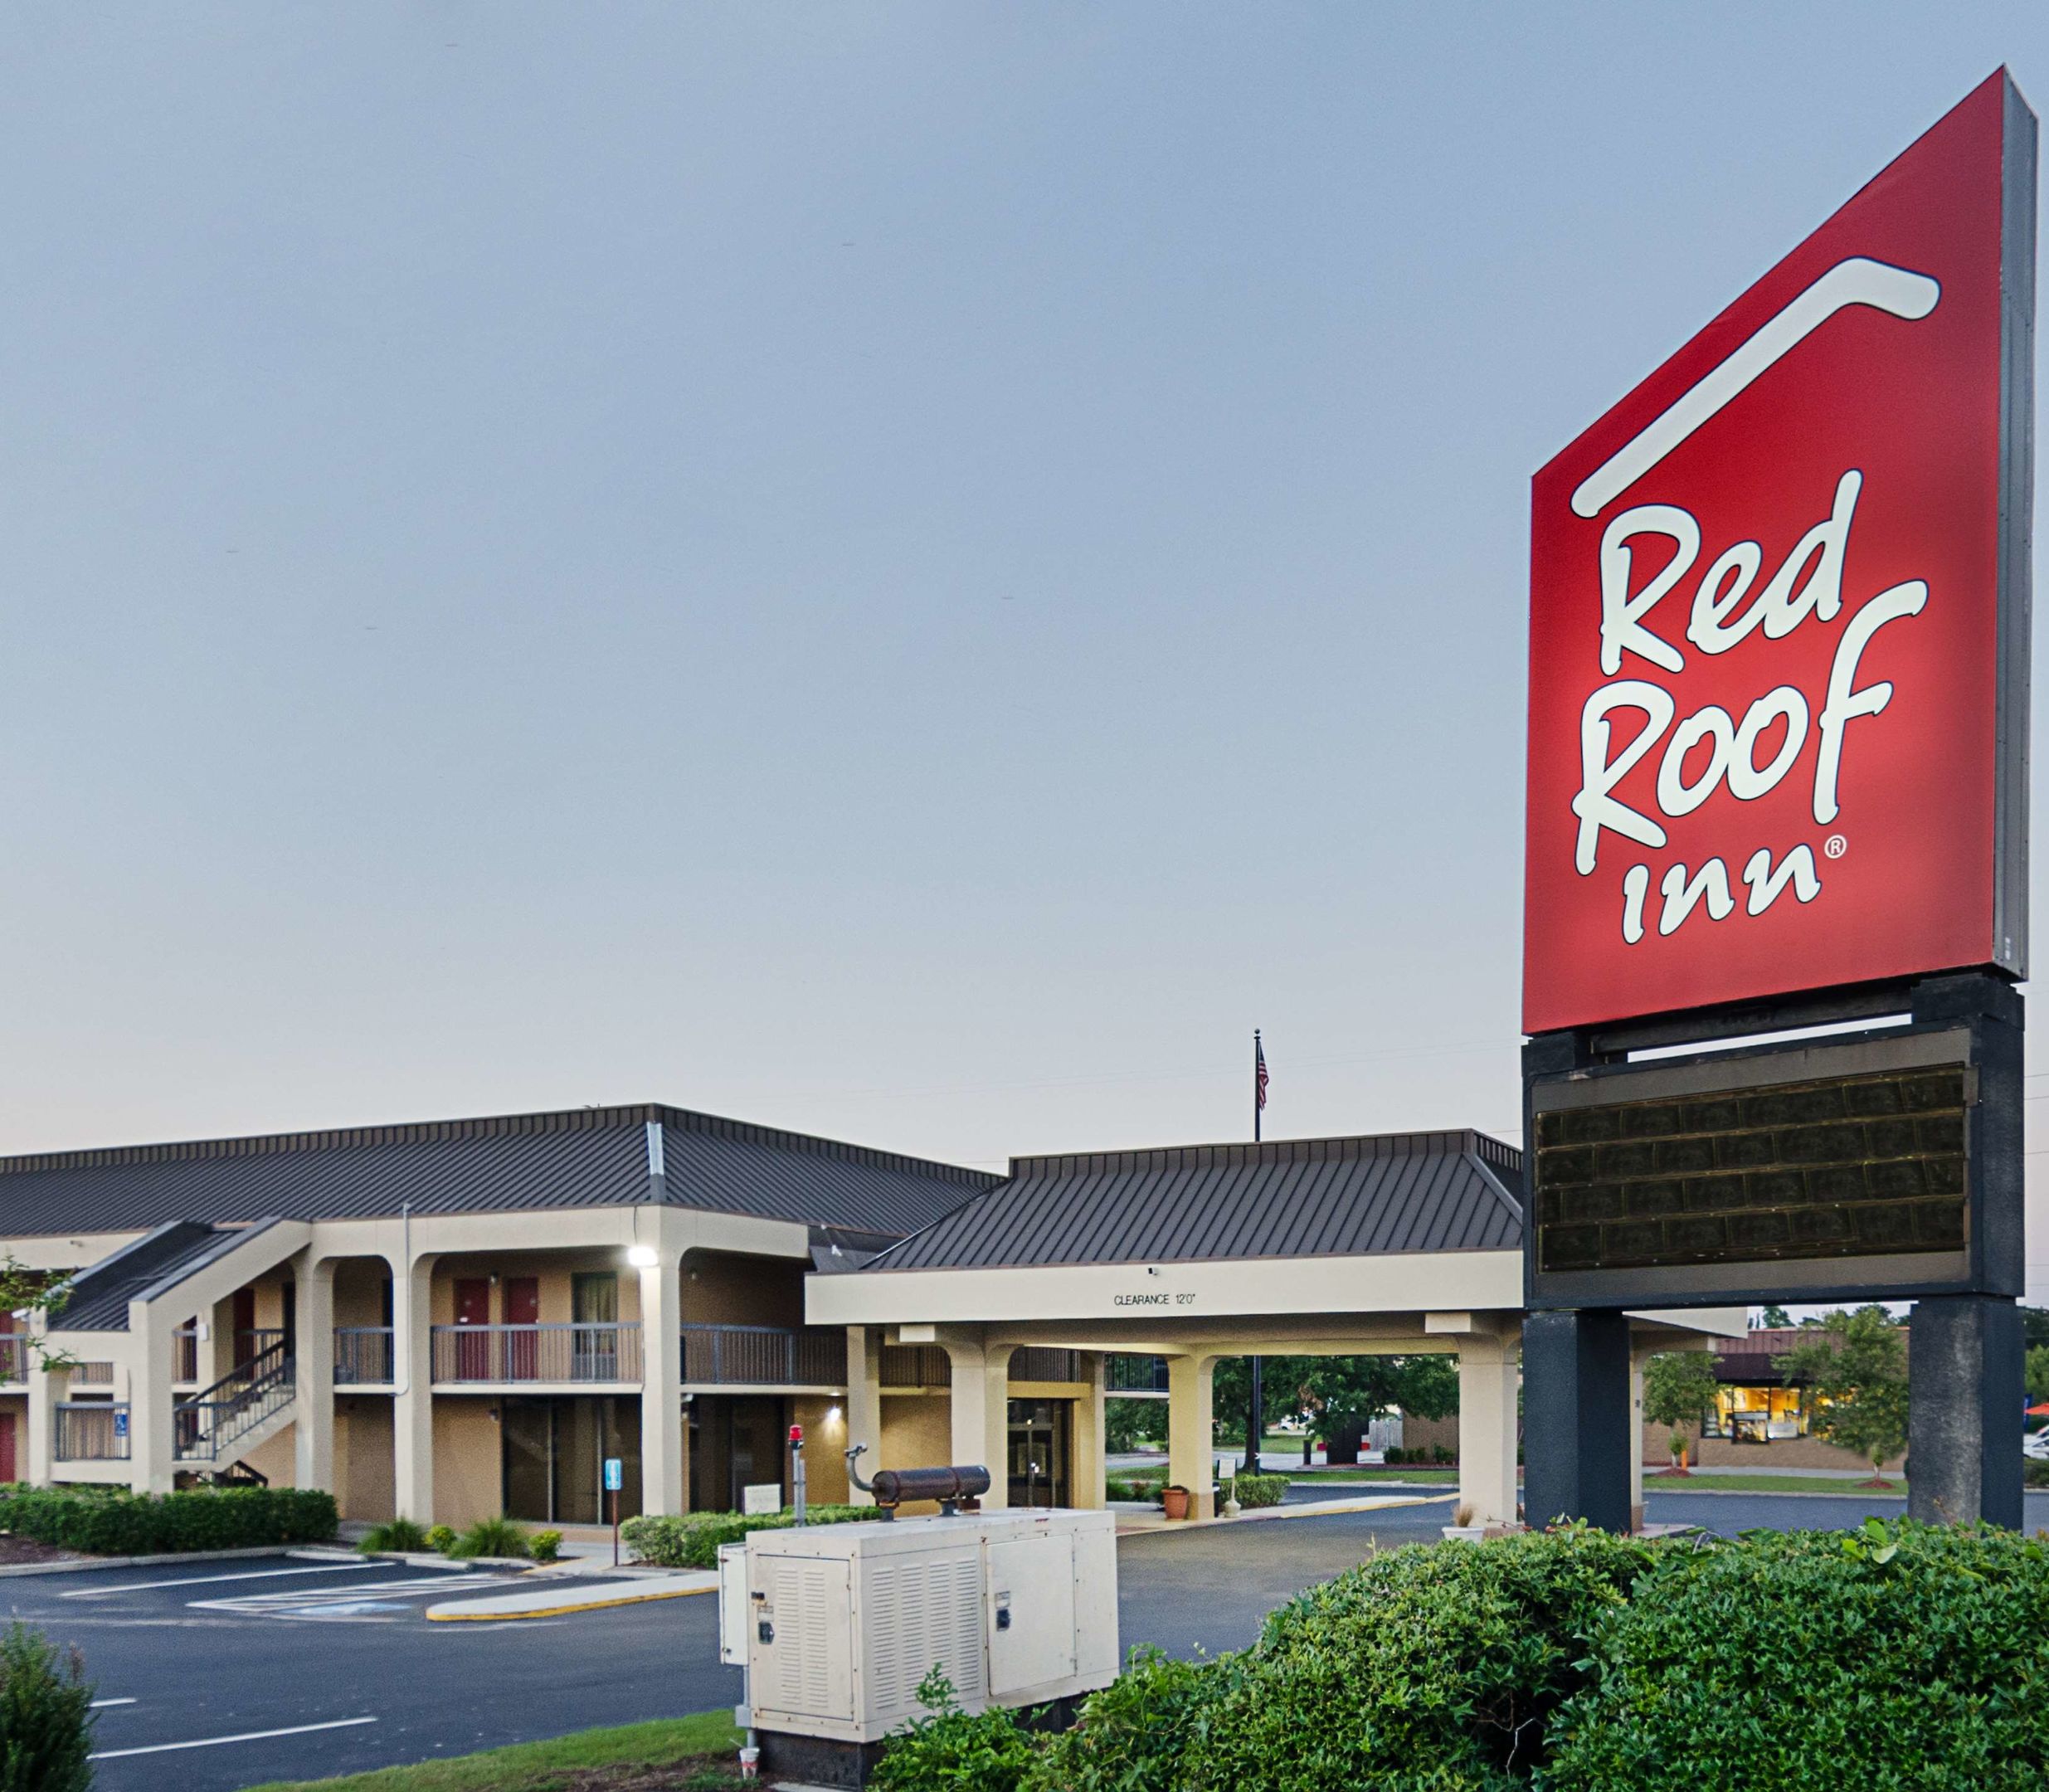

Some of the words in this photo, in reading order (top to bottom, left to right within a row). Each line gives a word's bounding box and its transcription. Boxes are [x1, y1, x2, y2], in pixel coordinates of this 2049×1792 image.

[1599, 469, 1862, 676] Red
[1572, 578, 1929, 876] Roof
[1113, 1294, 1170, 1306] CLEARANCE
